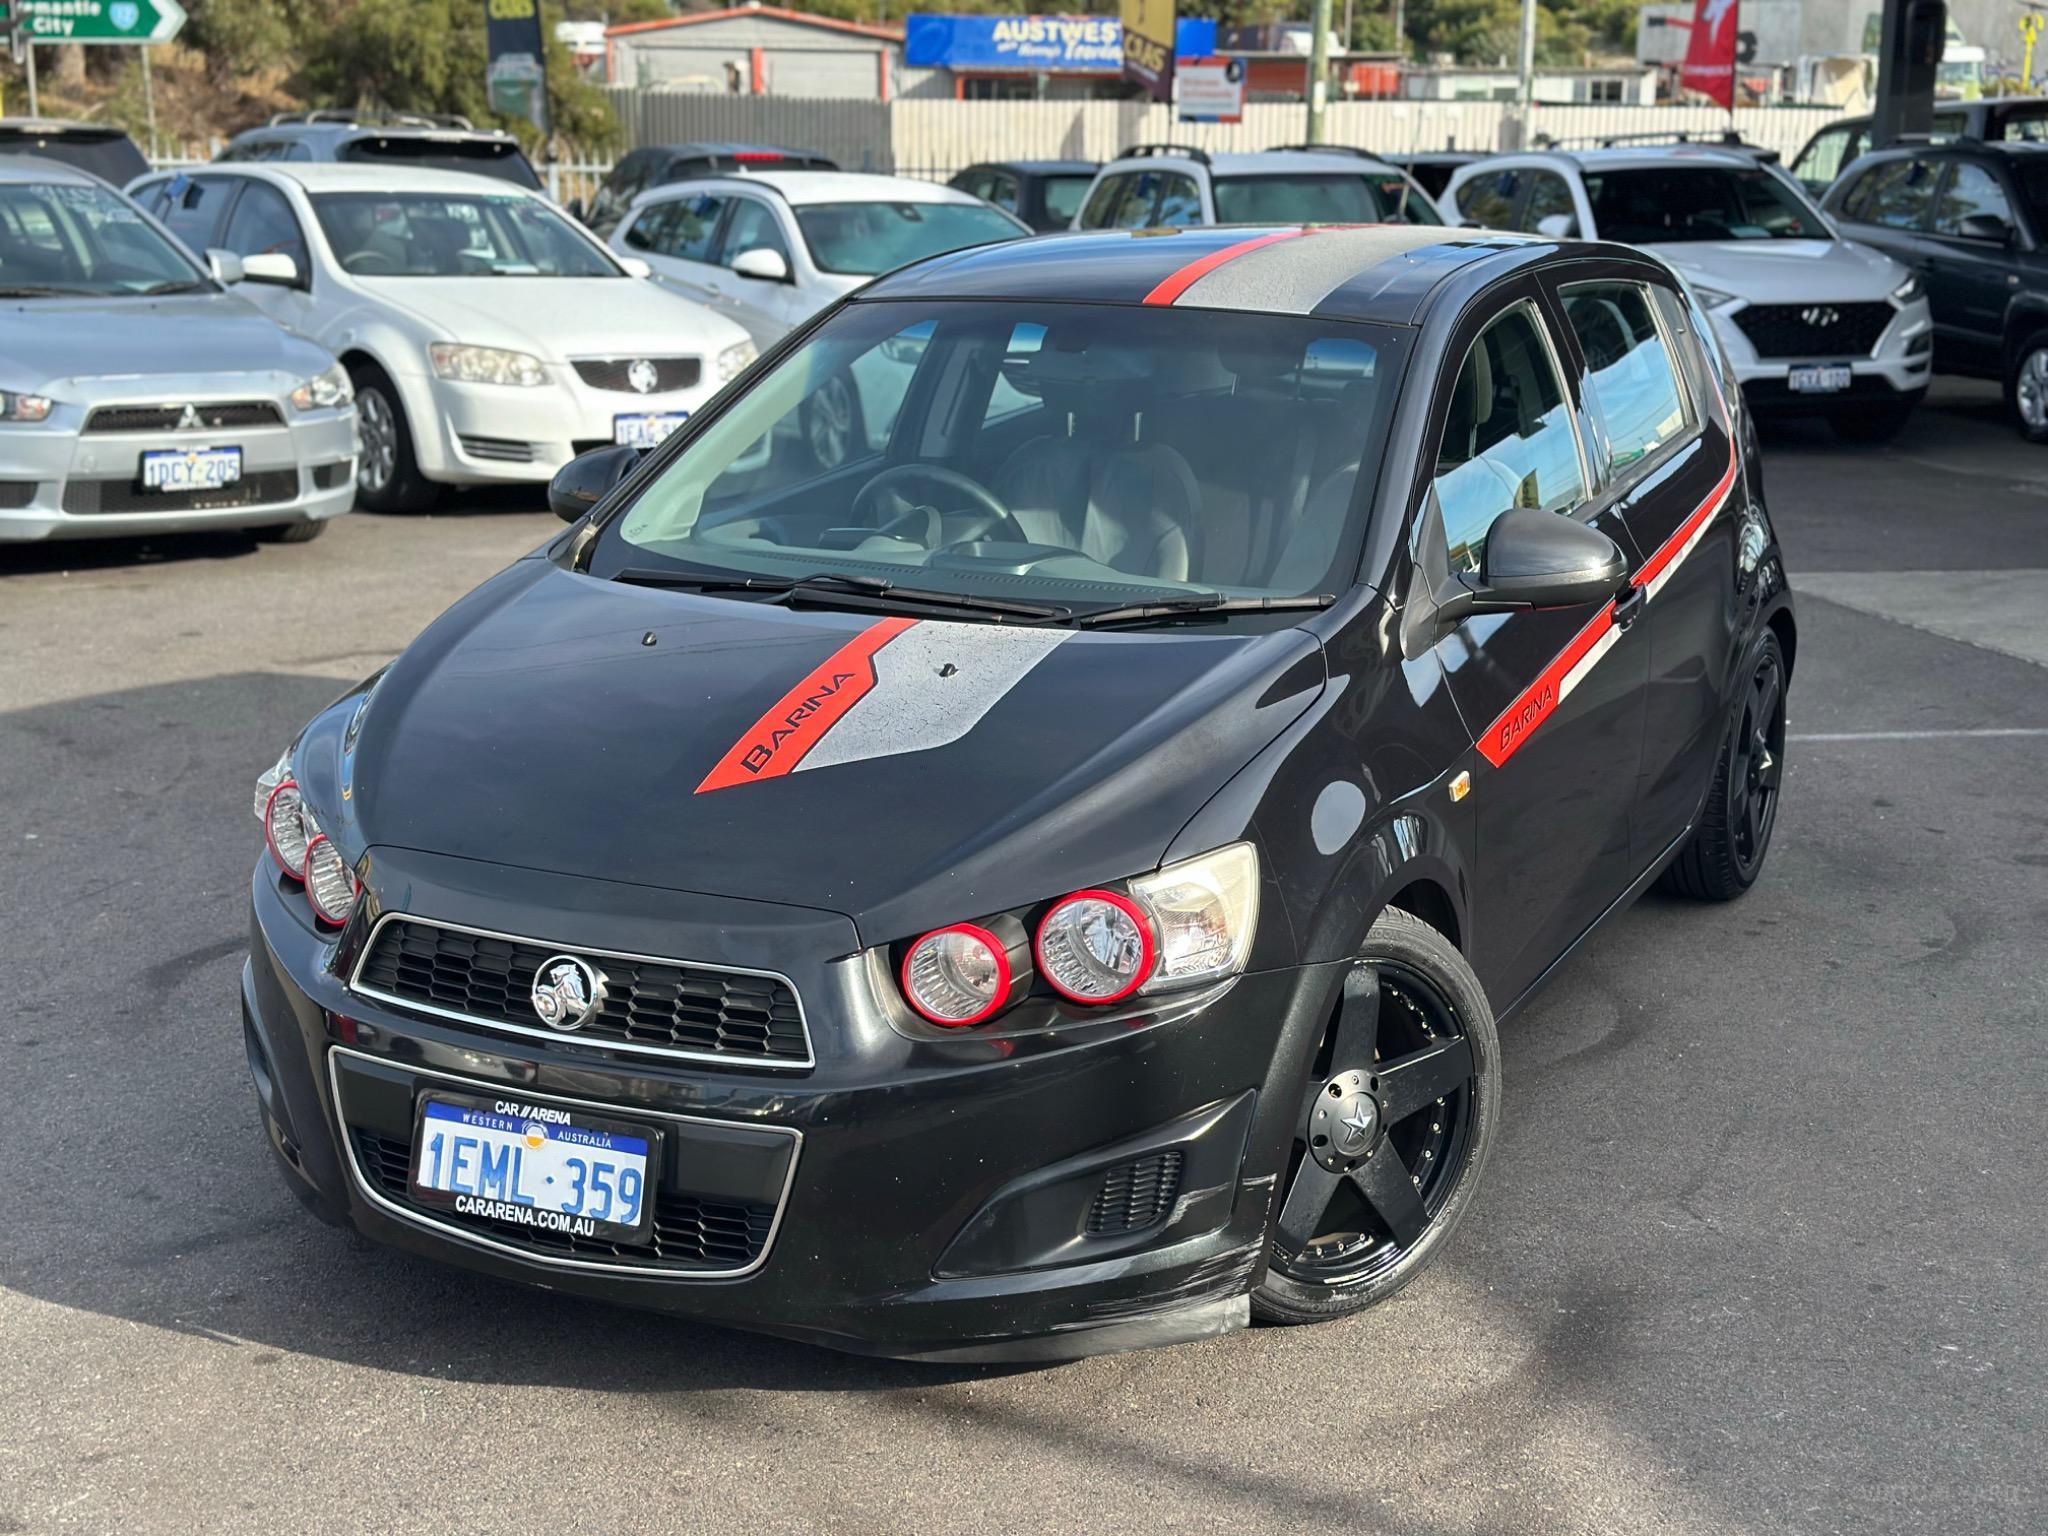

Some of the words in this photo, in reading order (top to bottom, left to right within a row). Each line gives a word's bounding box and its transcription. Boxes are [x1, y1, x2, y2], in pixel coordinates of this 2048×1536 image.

[33, 16, 74, 37] City
[206, 459, 238, 482] 205
[740, 671, 855, 774] BARINA
[1501, 684, 1552, 752] BARINA
[462, 1113, 513, 1131] WESTERN
[557, 1130, 612, 1149] AUSTRALIA
[455, 1195, 595, 1237] CARARENA.COM.AU
